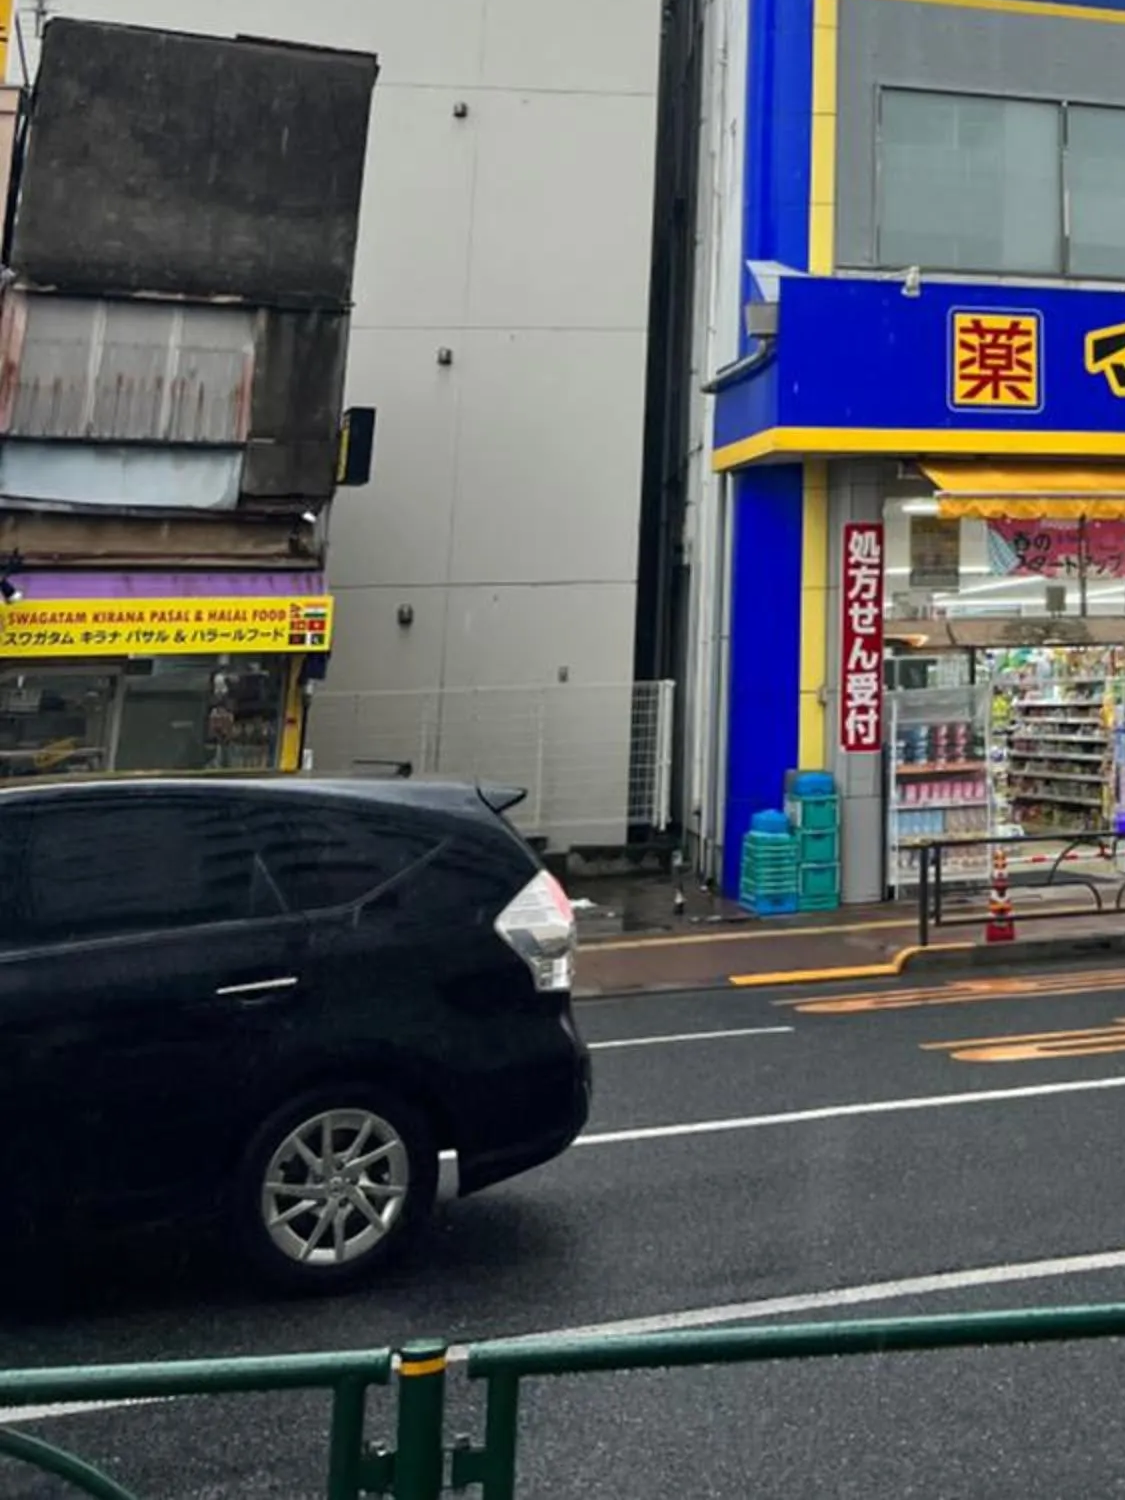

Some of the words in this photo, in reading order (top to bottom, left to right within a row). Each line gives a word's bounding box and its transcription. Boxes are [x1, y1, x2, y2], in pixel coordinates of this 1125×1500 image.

[958, 320, 1033, 401] 薬
[4, 630, 75, 646] スワガタム
[81, 630, 122, 645] キラナ
[173, 630, 187, 643] &
[191, 628, 285, 643] ハラールフード
[8, 611, 86, 625] SWAGATAM
[92, 610, 144, 623] KIRANA
[151, 609, 190, 623] PASAL
[207, 609, 248, 622] HALAL
[252, 609, 287, 621] FOOD
[845, 529, 881, 746] 処方せん受付
